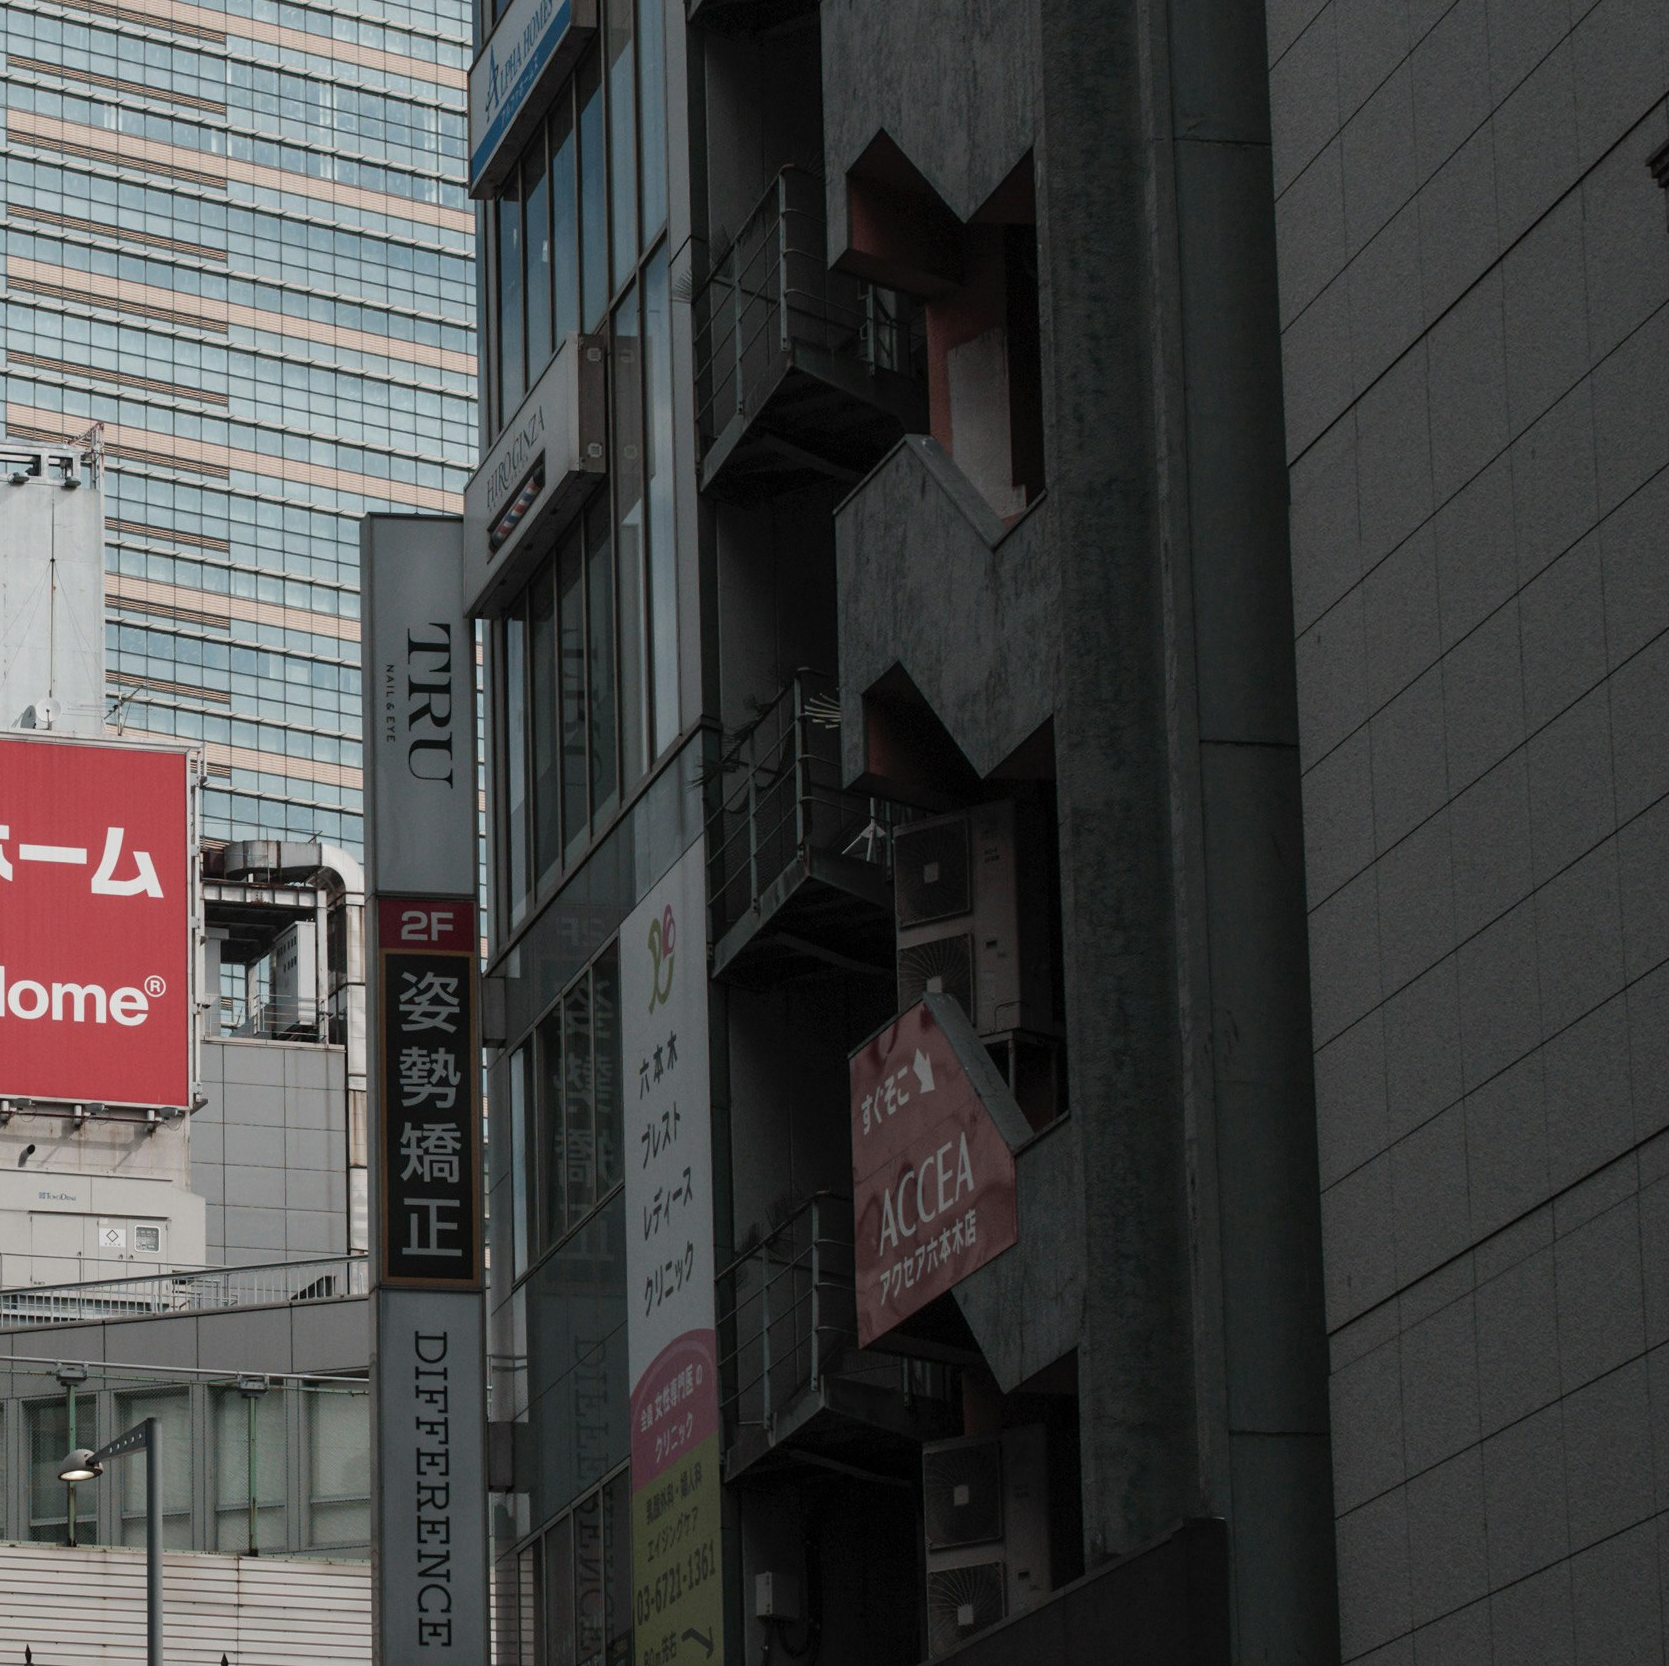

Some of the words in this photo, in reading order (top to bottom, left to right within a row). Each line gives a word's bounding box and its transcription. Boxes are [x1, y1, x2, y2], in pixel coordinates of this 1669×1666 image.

[485, 44, 522, 123] ALPHA
[386, 664, 395, 698] NAIL
[407, 622, 454, 789] TRU
[386, 714, 395, 743] EYE
[400, 910, 454, 942] 2F
[639, 1030, 678, 1100] 六本木
[860, 1065, 910, 1136] すぐそこ
[398, 970, 463, 1258] 姿勢矯正
[641, 1101, 681, 1169] ブレスト
[644, 1166, 693, 1241] レディース
[879, 1131, 975, 1257] ACCEA
[645, 1241, 693, 1318] クリニック
[879, 1209, 977, 1307] アクセア六本木店
[655, 1411, 693, 1464] クリニック
[414, 1330, 452, 1648] DIFFERENCE
[636, 1539, 716, 1626] 03-6721-1361
